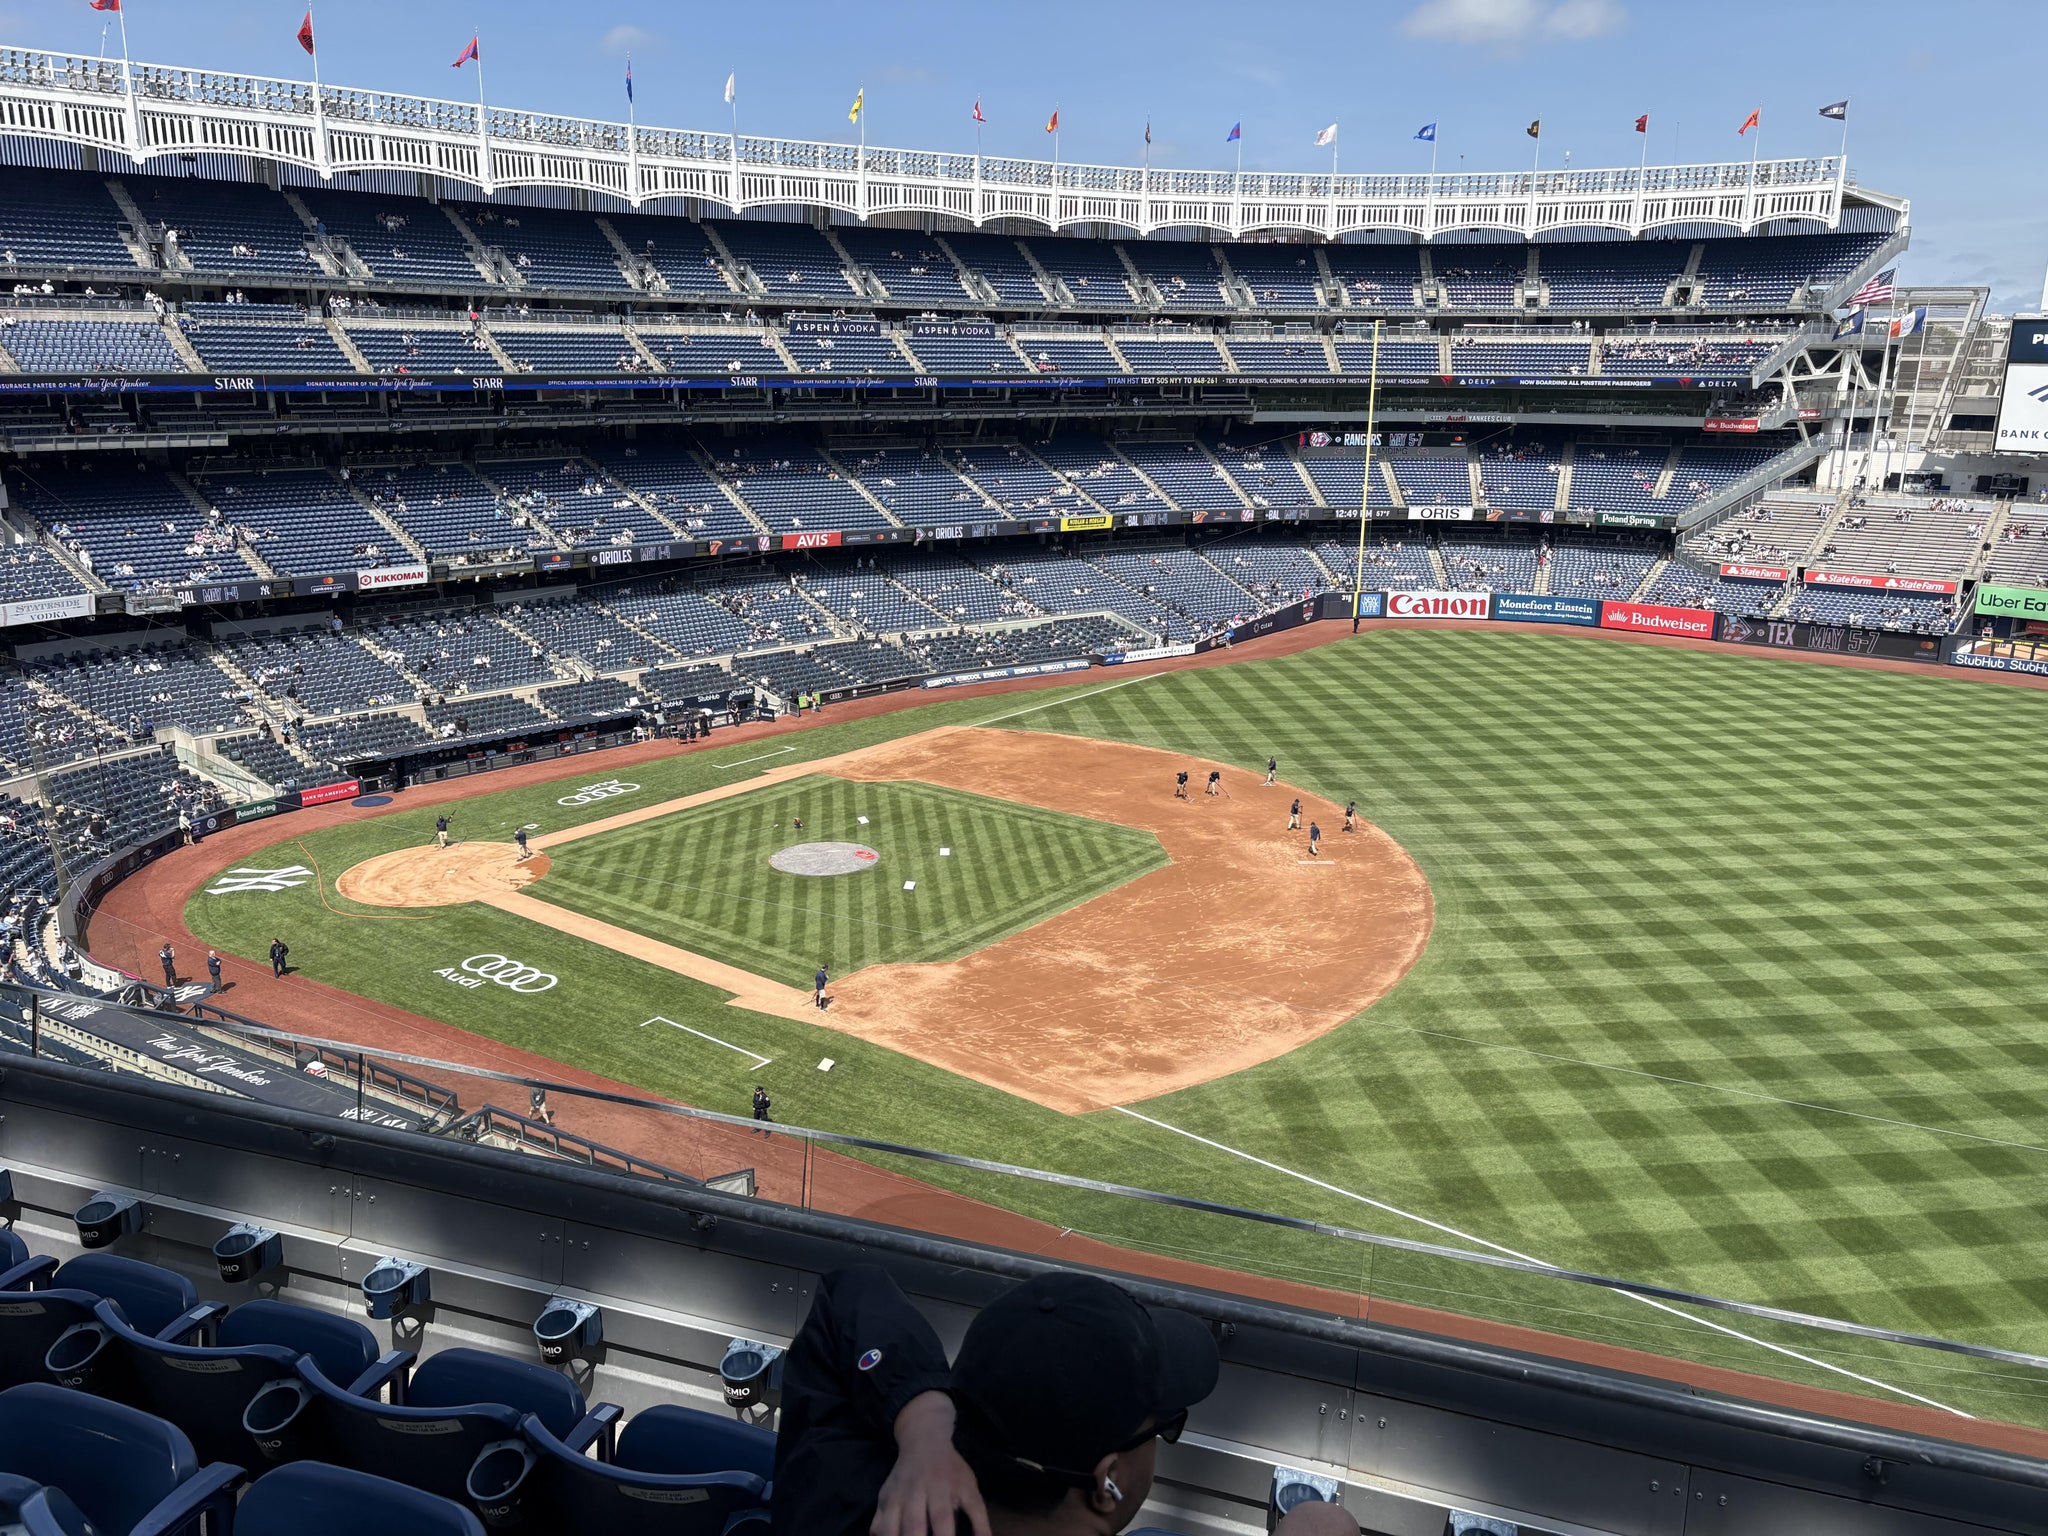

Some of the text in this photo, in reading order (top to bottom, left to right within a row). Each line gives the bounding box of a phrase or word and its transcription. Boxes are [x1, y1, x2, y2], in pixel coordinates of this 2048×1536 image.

[796, 323, 876, 332] ASPEN VODKA
[918, 326, 990, 335] ASPEN VODKA
[82, 378, 100, 388] New
[101, 378, 117, 392] York
[120, 378, 150, 392] Yankees
[214, 378, 254, 390] STARR
[472, 378, 504, 389] STARR
[730, 376, 758, 386] STARR
[914, 377, 938, 387] STARR
[1344, 434, 1424, 446] RANGRS MAY 5-7
[2000, 430, 2039, 439] BANK
[1268, 510, 1280, 520] BAL
[1335, 510, 1358, 518] 12:49
[1420, 508, 1460, 519] ORIS
[1128, 515, 1138, 526] BAL
[1602, 514, 1656, 527] Poland Spring
[935, 526, 964, 539] ORIOLES
[796, 534, 829, 547] AVIS
[599, 550, 632, 565] ORIOLES
[374, 572, 424, 583] KIKKOMAN
[178, 586, 239, 604] BAL MAY 1-4
[15, 600, 80, 614] STATESIDE
[1388, 594, 1488, 616] Canon
[1499, 599, 1592, 614] Montefiore Einstein
[1980, 593, 2048, 612] Uber Ea
[30, 610, 68, 621] VODKA
[1631, 612, 1706, 632] Budweiser
[1768, 622, 1796, 646] TEX
[1808, 626, 1845, 650] MAY
[1848, 630, 1880, 654] 5-7
[1955, 654, 2005, 669] StubHub
[2010, 660, 2048, 675] StubHu
[660, 700, 684, 708] StubHub
[698, 694, 720, 702] StubHub
[324, 788, 348, 798] AMERICA
[236, 804, 277, 819] Poland Spring
[432, 968, 486, 990] Audi
[146, 1034, 271, 1086] New York Yankees
